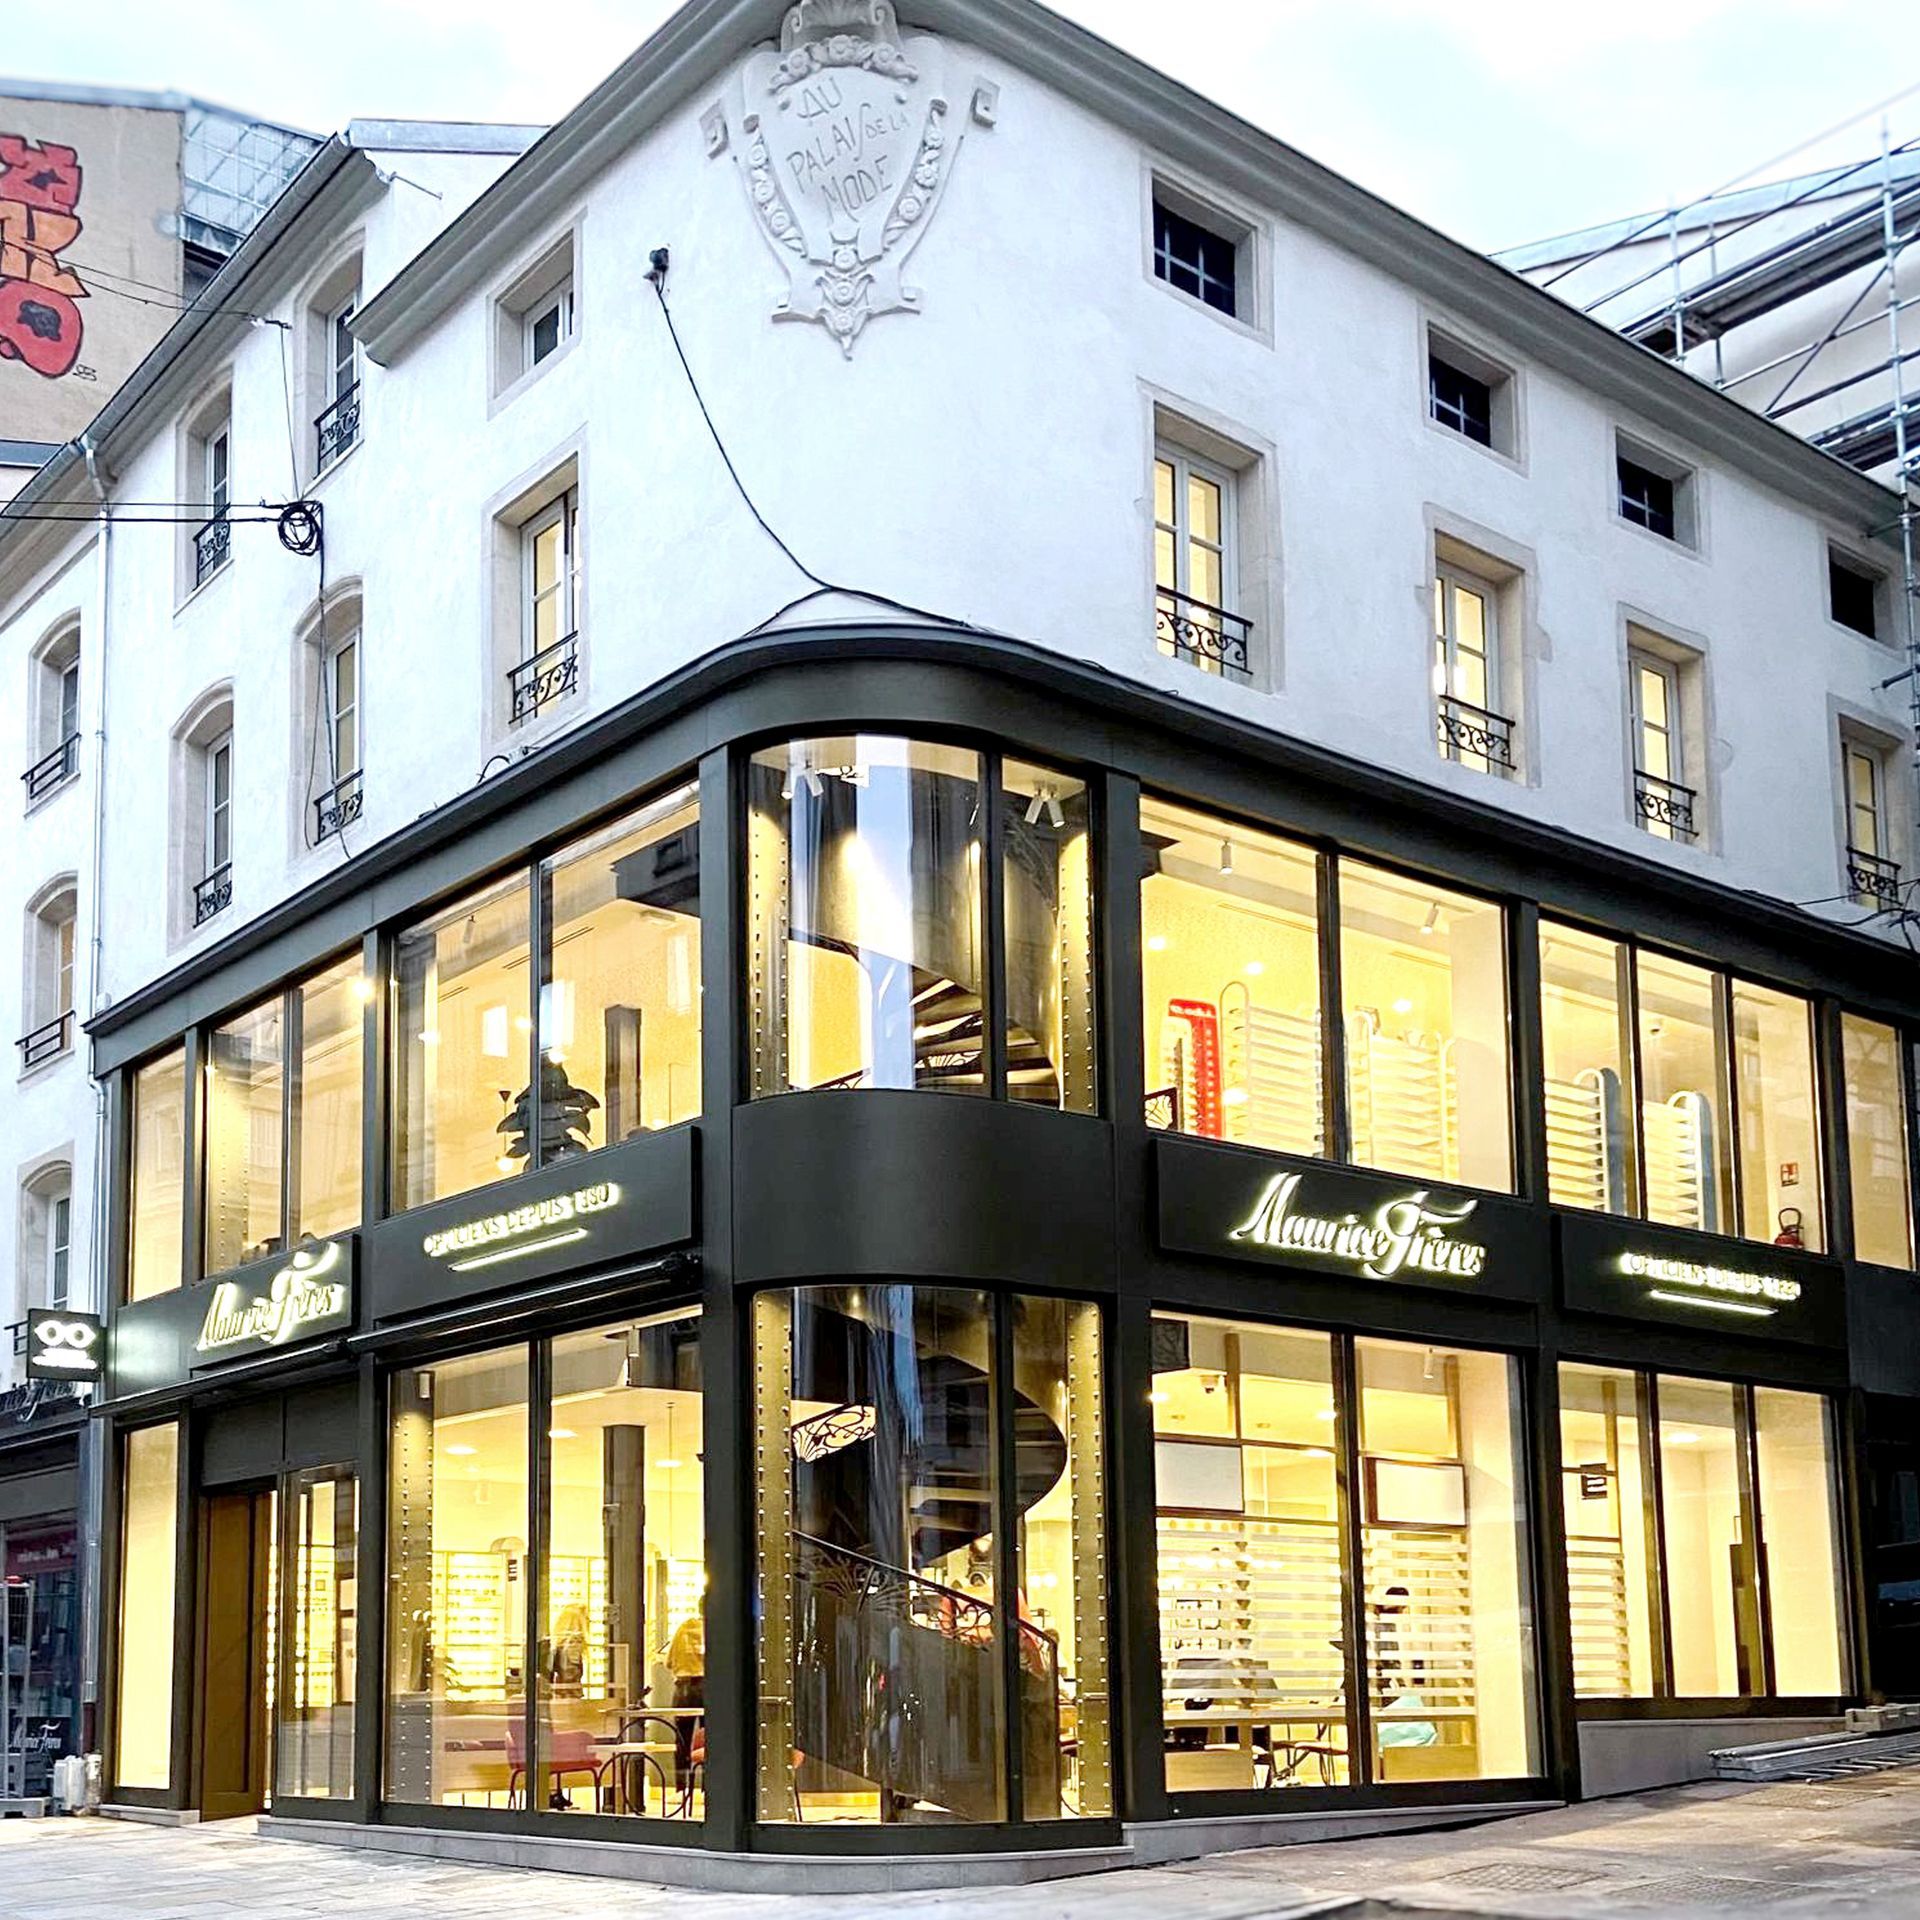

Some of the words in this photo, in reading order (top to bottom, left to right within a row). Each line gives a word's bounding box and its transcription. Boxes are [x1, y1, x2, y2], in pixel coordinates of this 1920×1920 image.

[796, 77, 843, 120] AU
[786, 103, 872, 194] PALAIS
[865, 118, 888, 139] DE
[821, 154, 893, 223] MODE
[1229, 1172, 1391, 1261] Maurice
[196, 1282, 278, 1351] Maurice
